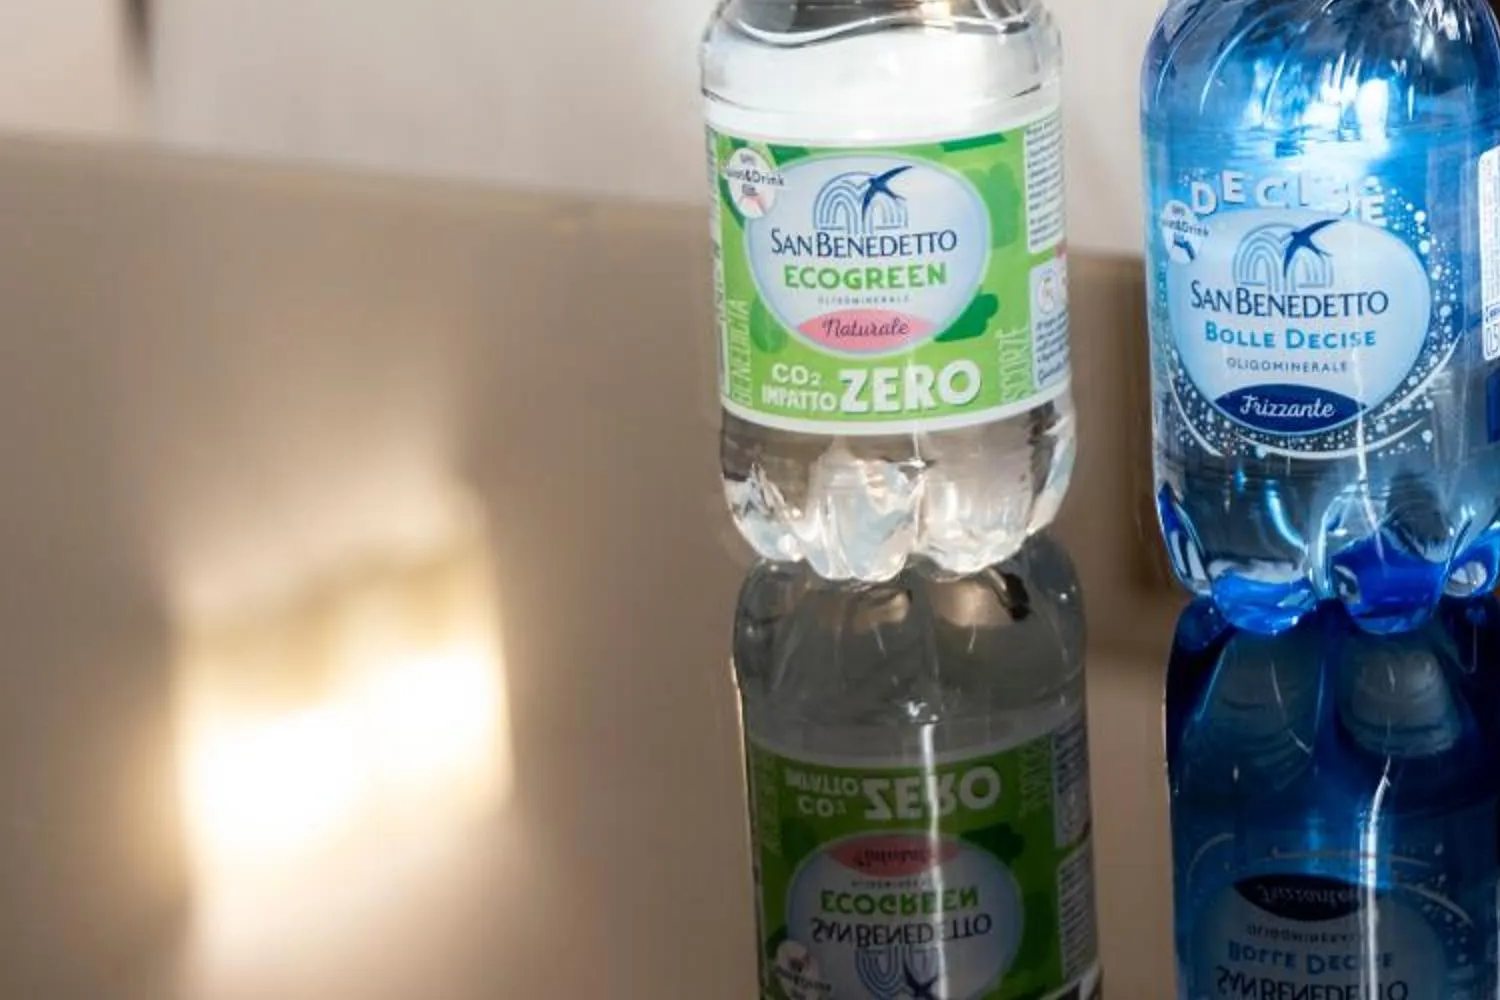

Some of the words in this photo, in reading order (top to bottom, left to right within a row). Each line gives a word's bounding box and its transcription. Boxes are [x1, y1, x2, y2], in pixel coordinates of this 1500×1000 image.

[784, 262, 947, 290] ECOGREEN
[822, 317, 909, 338] Naturale
[1205, 320, 1276, 348] BOLLE
[1285, 328, 1377, 349] DECISE
[1226, 356, 1348, 373] OLIGOMINERALE
[762, 384, 837, 412] IMPATTO
[839, 359, 982, 413] ZERO
[1239, 394, 1336, 418] Frizzante
